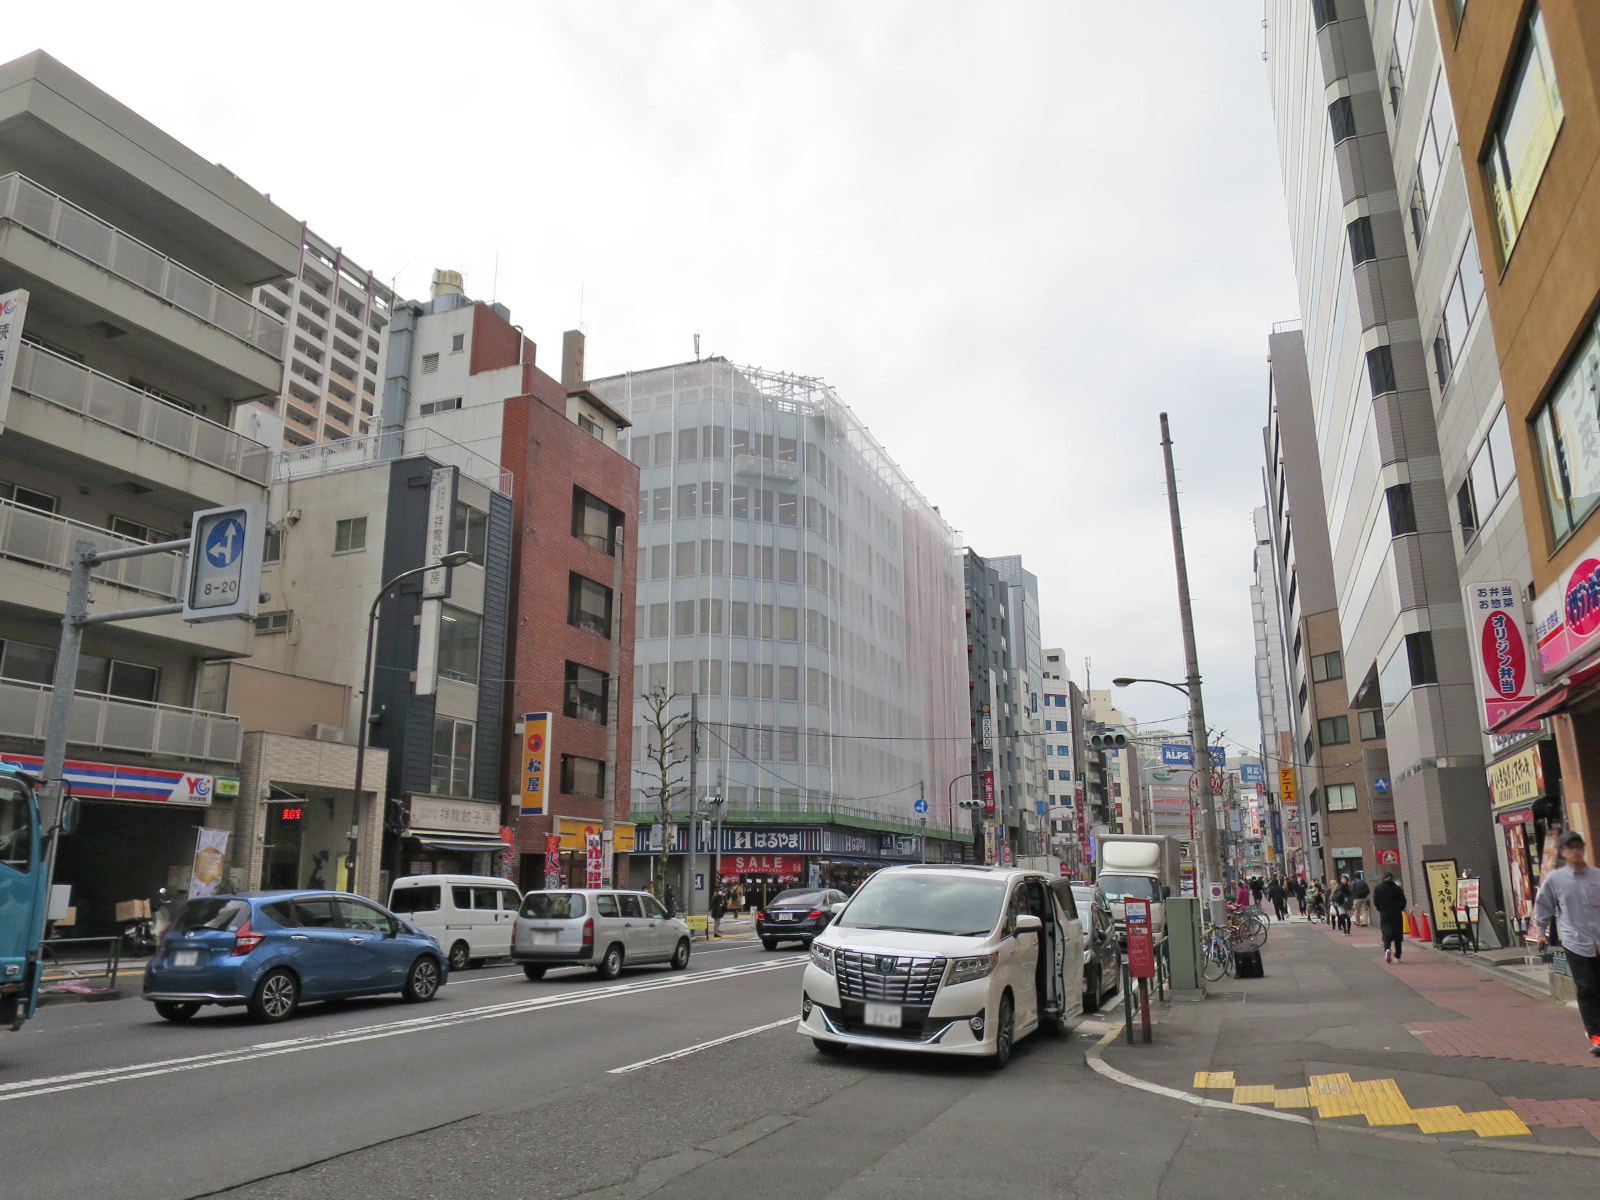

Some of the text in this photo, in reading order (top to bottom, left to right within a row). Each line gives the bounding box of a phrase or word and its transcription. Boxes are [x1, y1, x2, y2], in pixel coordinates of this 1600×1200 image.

[204, 580, 237, 595] 8-20
[1477, 586, 1512, 597] お弁当
[1479, 598, 1514, 609] お惣菜
[1492, 615, 1516, 693] オリジン弁当
[1165, 750, 1189, 760] ALPS
[526, 757, 542, 793] 松屋
[985, 777, 994, 807] 大阪王将
[754, 832, 799, 849] はるやま
[735, 856, 783, 868] SALE
